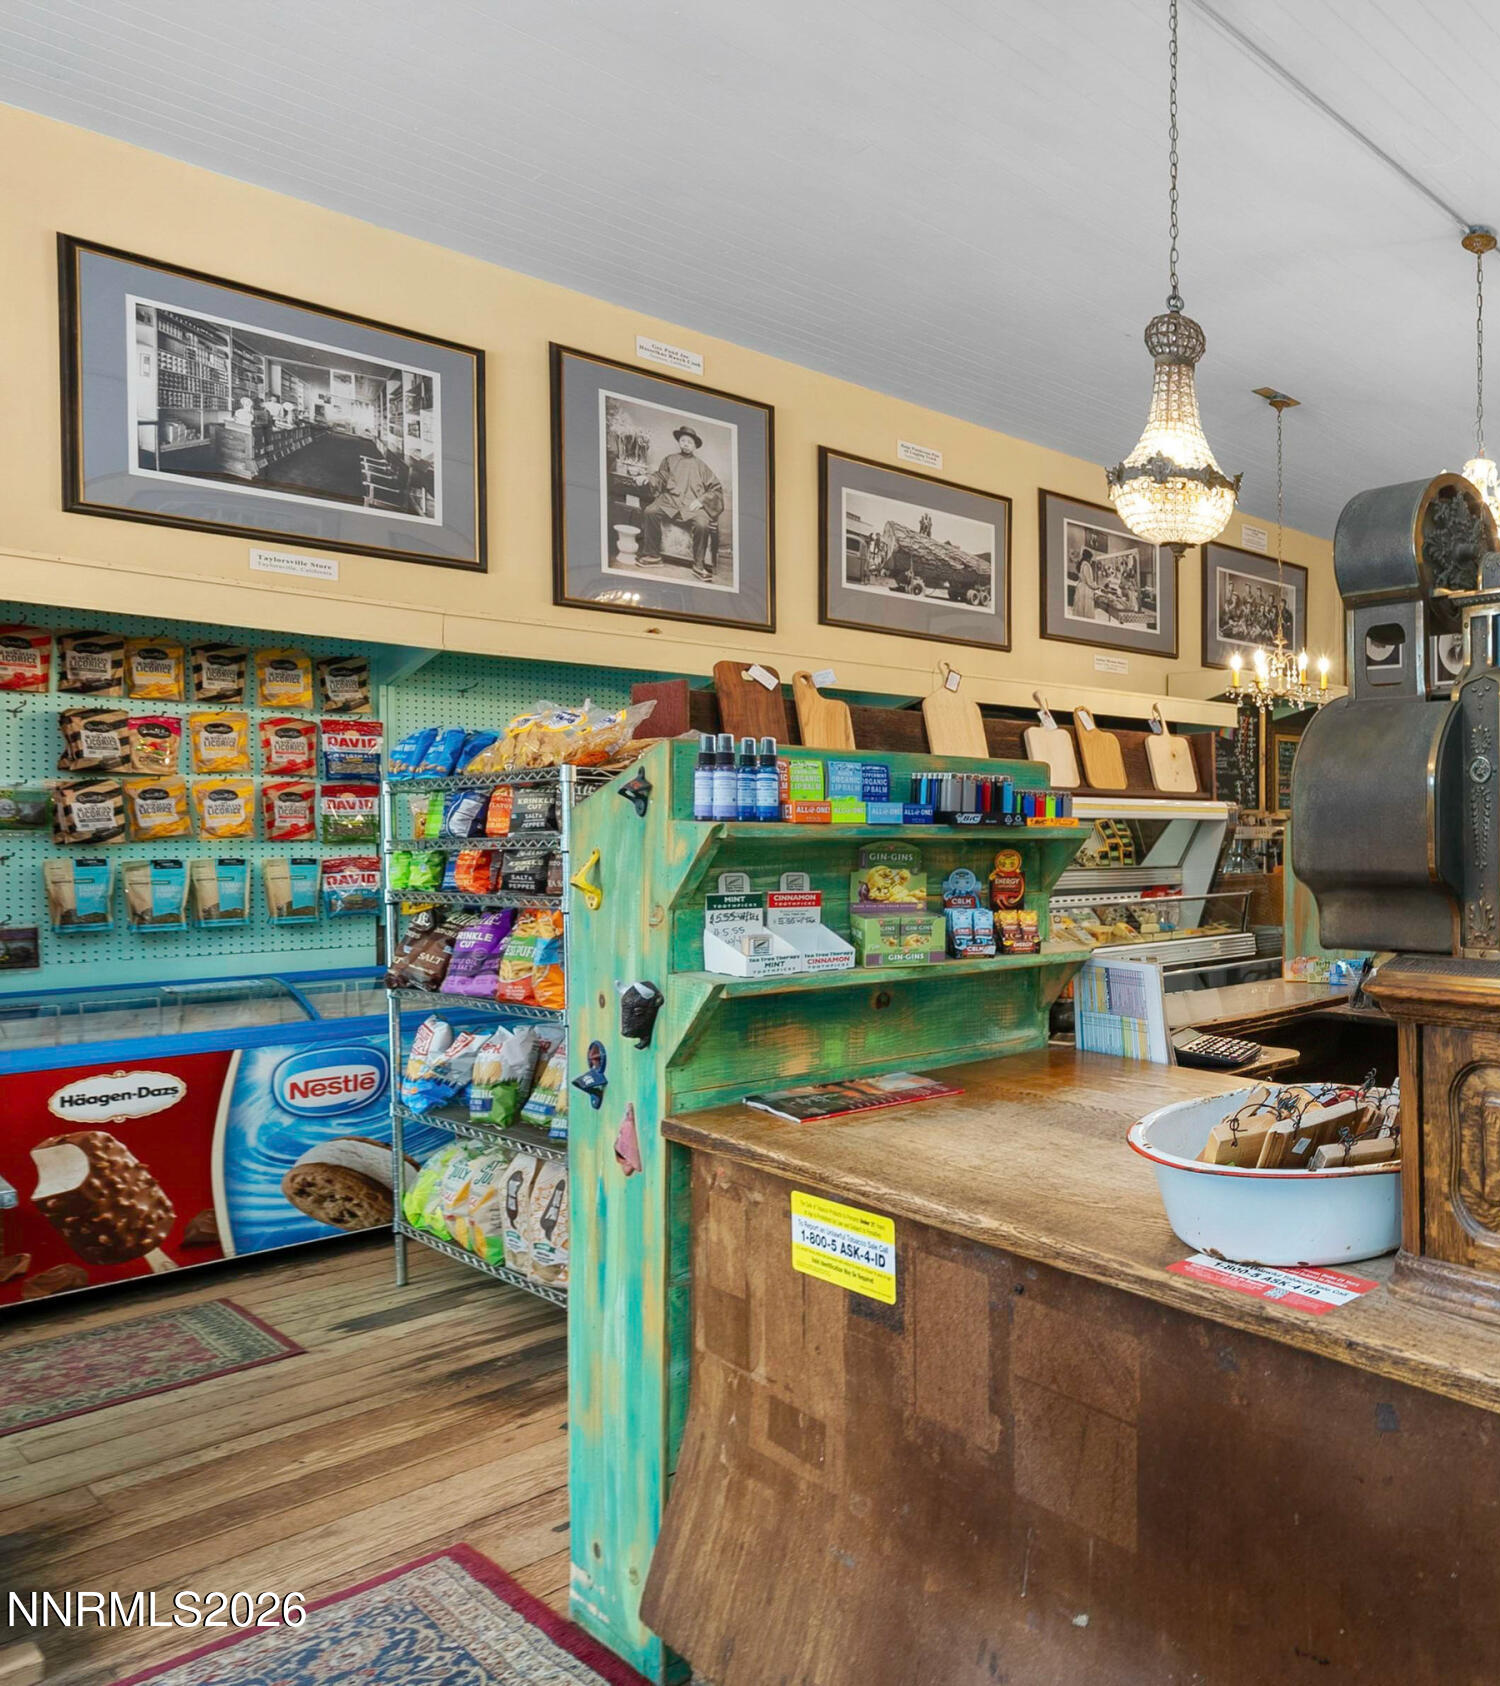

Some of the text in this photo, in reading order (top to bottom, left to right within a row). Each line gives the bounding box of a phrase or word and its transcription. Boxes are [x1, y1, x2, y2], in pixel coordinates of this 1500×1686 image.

[0, 653, 38, 665] ICORICE
[327, 735, 378, 749] DAVID
[869, 853, 913, 861] GIN-GINS
[326, 874, 377, 886] DAVID
[456, 931, 494, 942] RINKLE
[460, 940, 476, 948] CUT
[418, 952, 445, 965] SALT
[807, 956, 850, 965] CINNAMON
[888, 952, 924, 961] GIN-GINS
[288, 1071, 377, 1100] Nestlé
[59, 1084, 181, 1110] Häagen-Dazs
[801, 1229, 886, 1268] 1-800-5 ASK-4-ID
